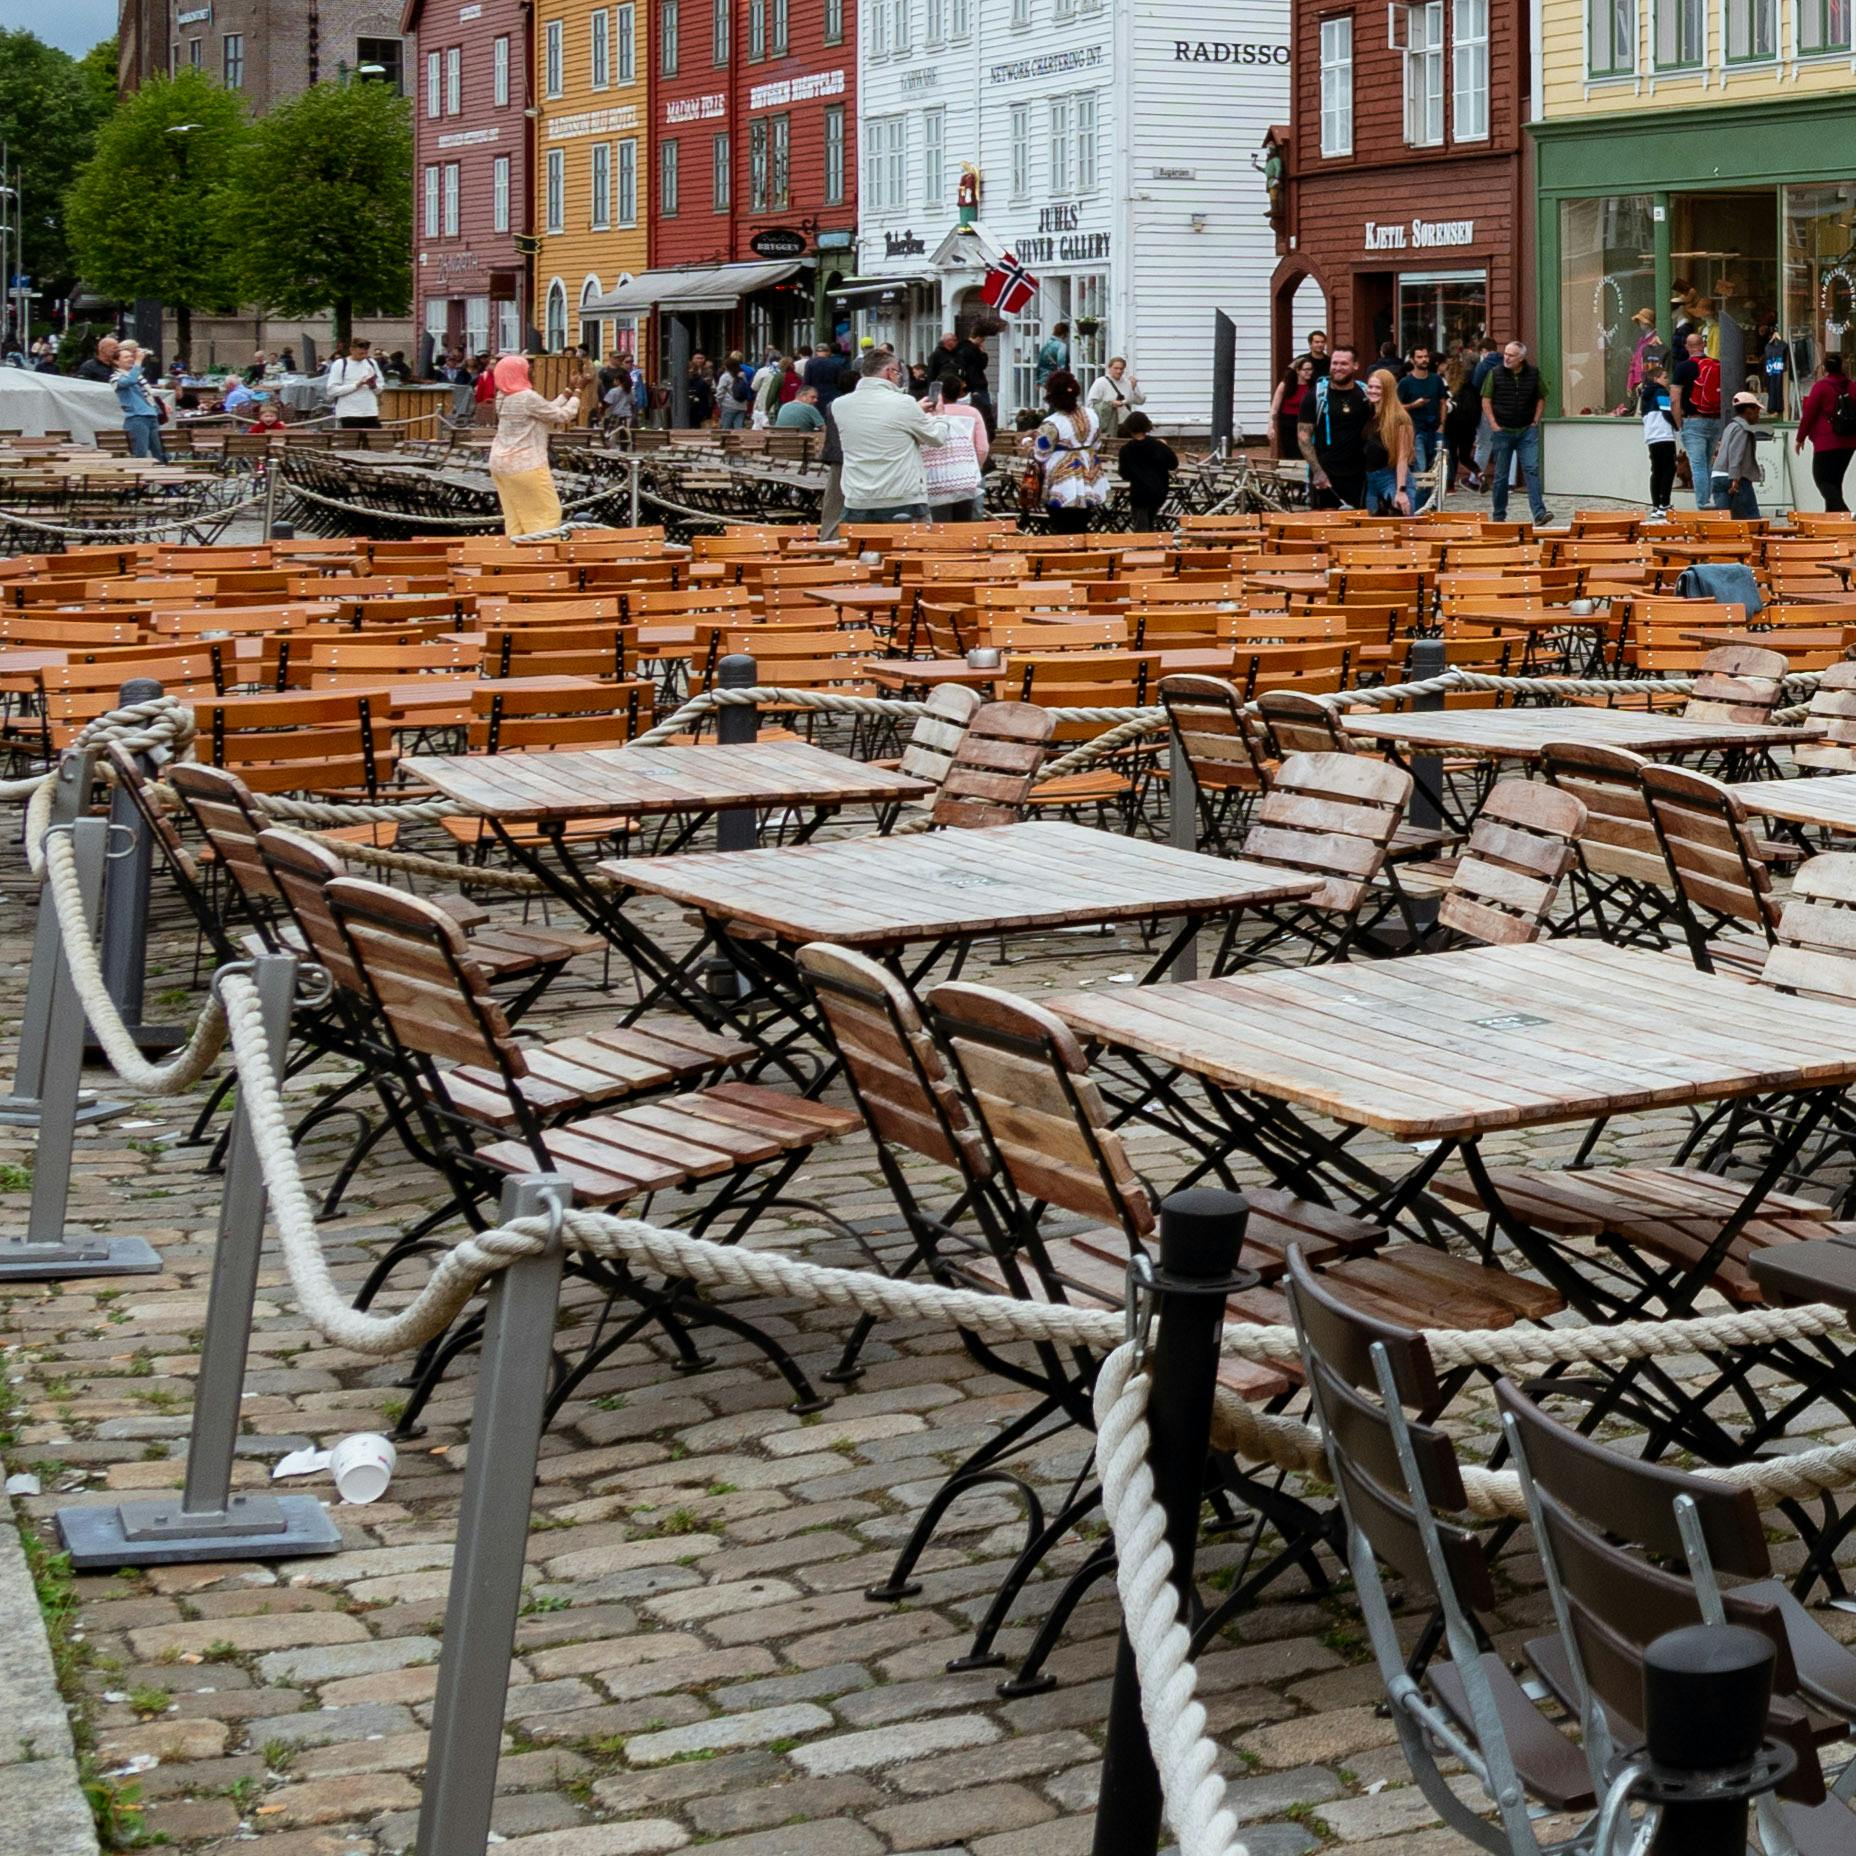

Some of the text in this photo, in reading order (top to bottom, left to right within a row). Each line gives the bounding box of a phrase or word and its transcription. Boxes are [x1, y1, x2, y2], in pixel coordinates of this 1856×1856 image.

[1174, 40, 1291, 64] RADISSO
[1015, 232, 1111, 263] SILVER GALLERY
